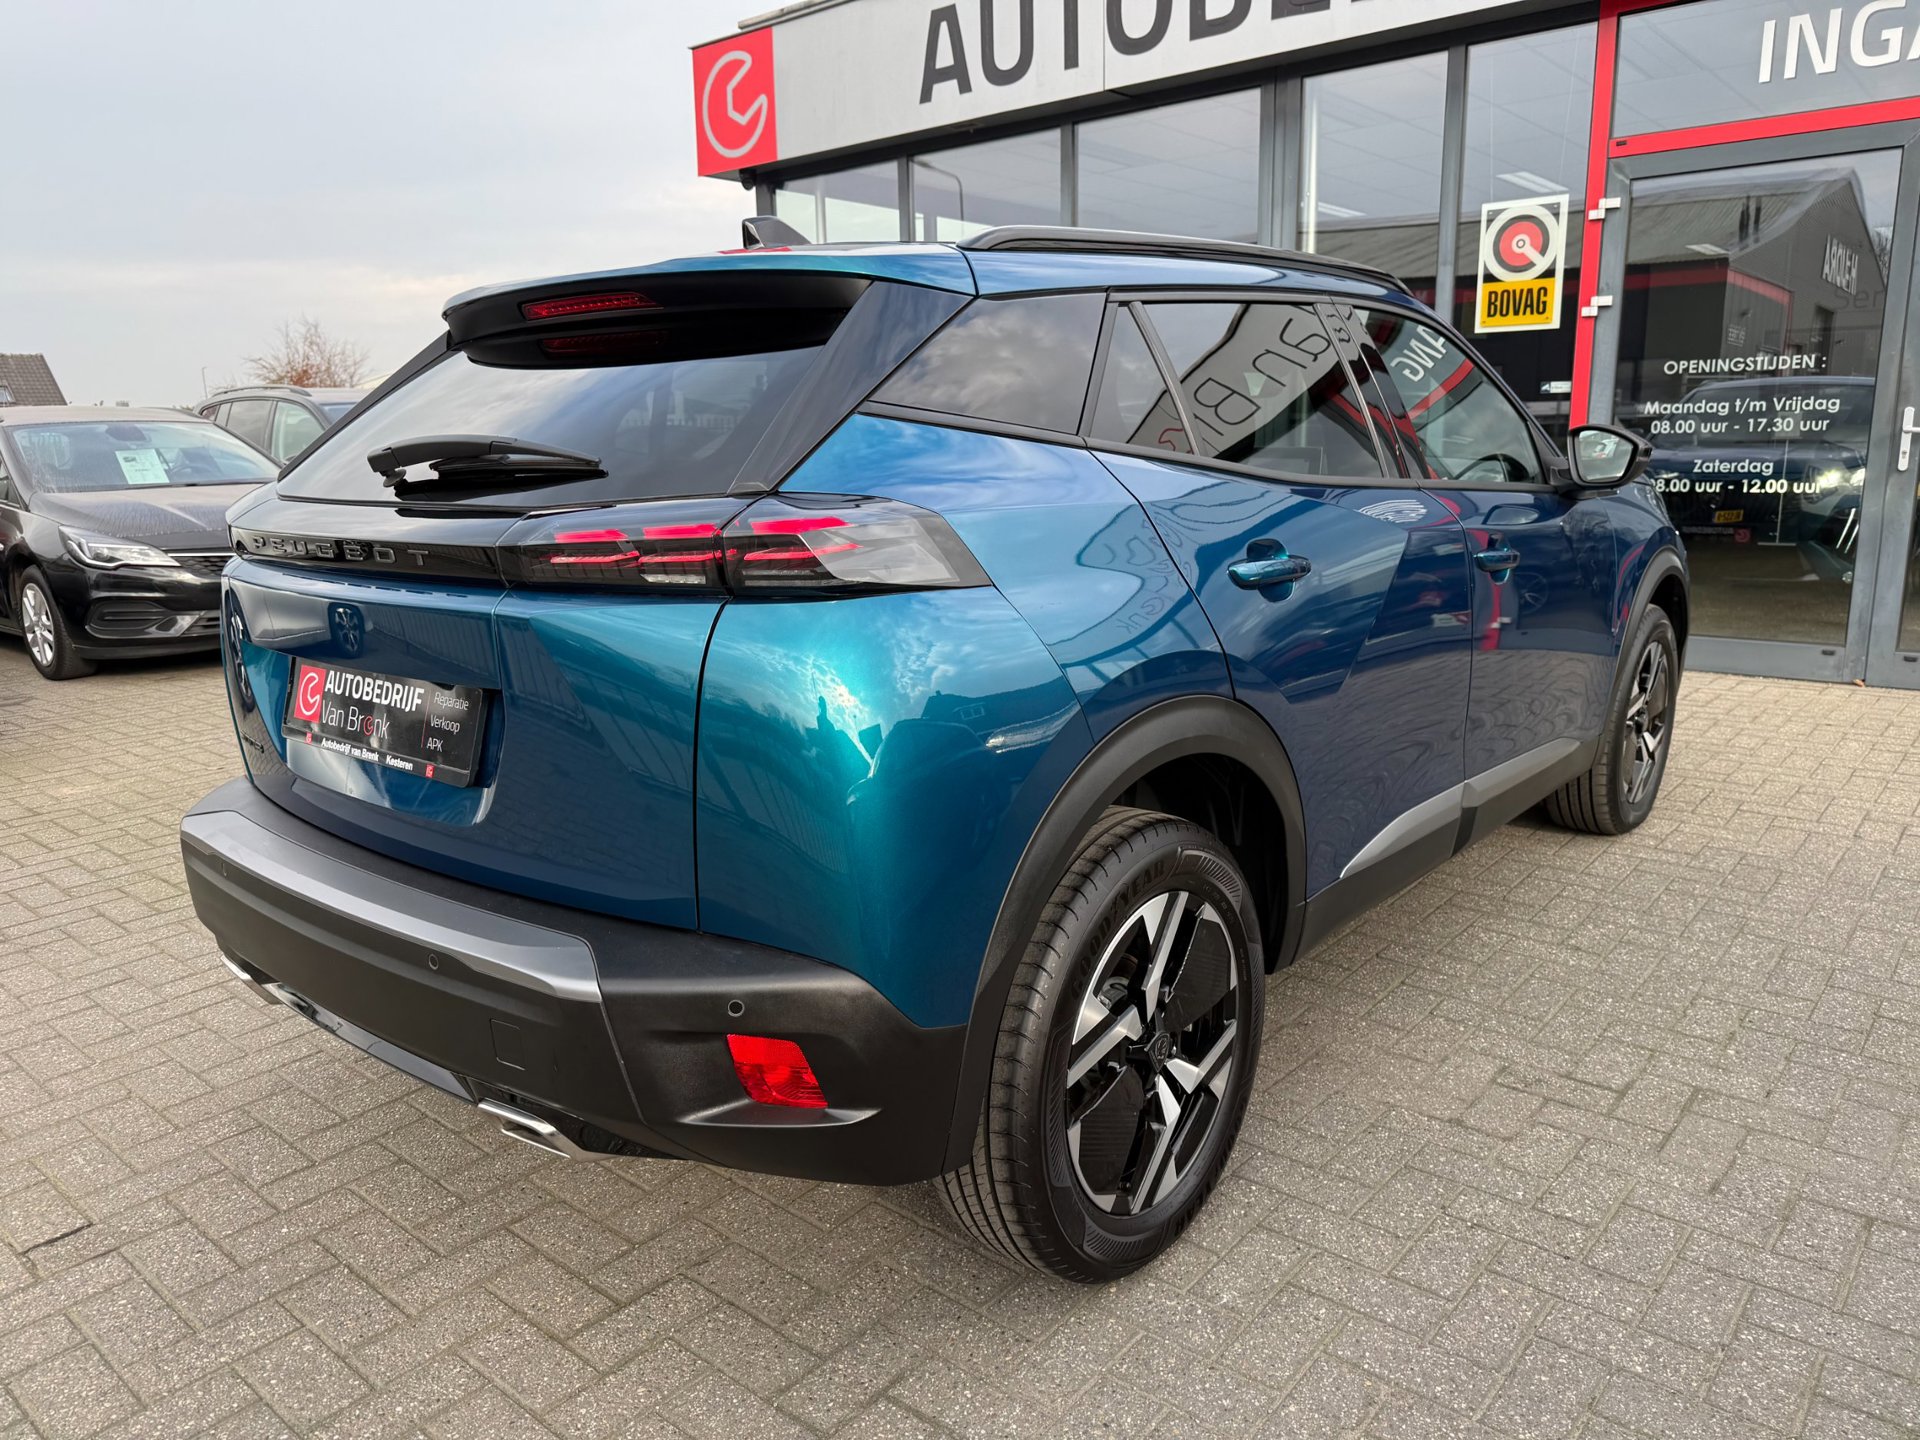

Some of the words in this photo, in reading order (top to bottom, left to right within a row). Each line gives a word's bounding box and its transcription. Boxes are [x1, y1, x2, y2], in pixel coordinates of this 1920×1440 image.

[1758, 0, 1920, 84] ING
[1486, 285, 1548, 319] BOVAG
[1663, 354, 1816, 375] OPENINGSTIJDEN
[1643, 399, 1729, 416] Maandag
[1735, 397, 1767, 414] t/m
[1773, 395, 1841, 414] Vrijdag
[1650, 420, 1696, 434] 08.00
[1701, 421, 1728, 433] uur
[1747, 417, 1794, 432] 17.30
[1800, 418, 1830, 432] uur
[1692, 459, 1774, 477] Zaterdag
[1695, 481, 1723, 493] uur
[1741, 478, 1788, 494] 12.00
[252, 535, 430, 567] PEUGEOT
[325, 670, 425, 712] AUTOBEDRIJF
[434, 691, 470, 711] Reparatie
[321, 699, 345, 728] Van
[430, 714, 461, 735] Verkoop
[320, 738, 352, 756] Autobedrijf
[351, 746, 362, 757] van
[361, 748, 379, 762] Brenk
[386, 755, 413, 771] Kesteren
[427, 738, 444, 752] APK
